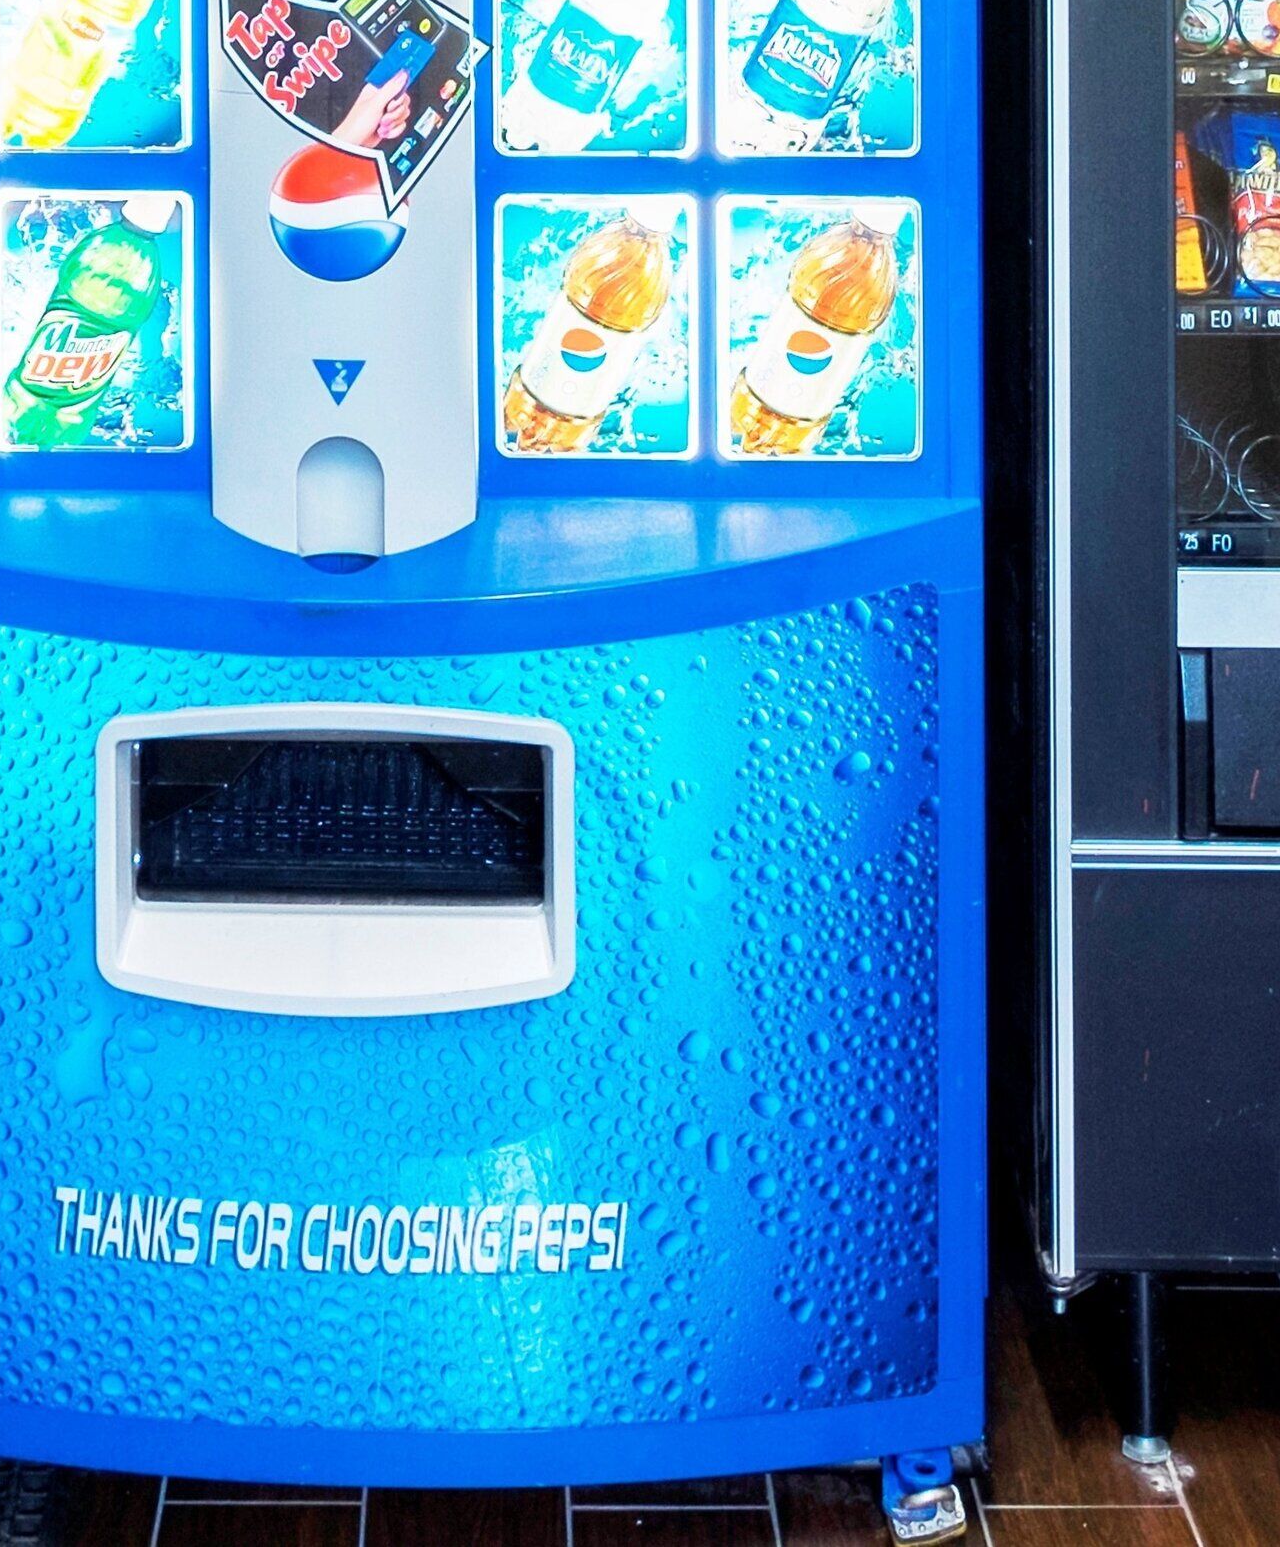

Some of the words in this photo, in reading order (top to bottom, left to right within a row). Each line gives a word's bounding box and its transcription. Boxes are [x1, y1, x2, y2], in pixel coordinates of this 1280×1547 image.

[262, 18, 353, 117] Swipe
[265, 40, 286, 69] or
[1210, 311, 1233, 328] E0
[1212, 534, 1233, 551] F0
[55, 1186, 202, 1265] THANKS
[208, 1199, 293, 1271] FOR
[301, 1200, 506, 1276] CHOOSING
[508, 1200, 629, 1274] PEPSI
